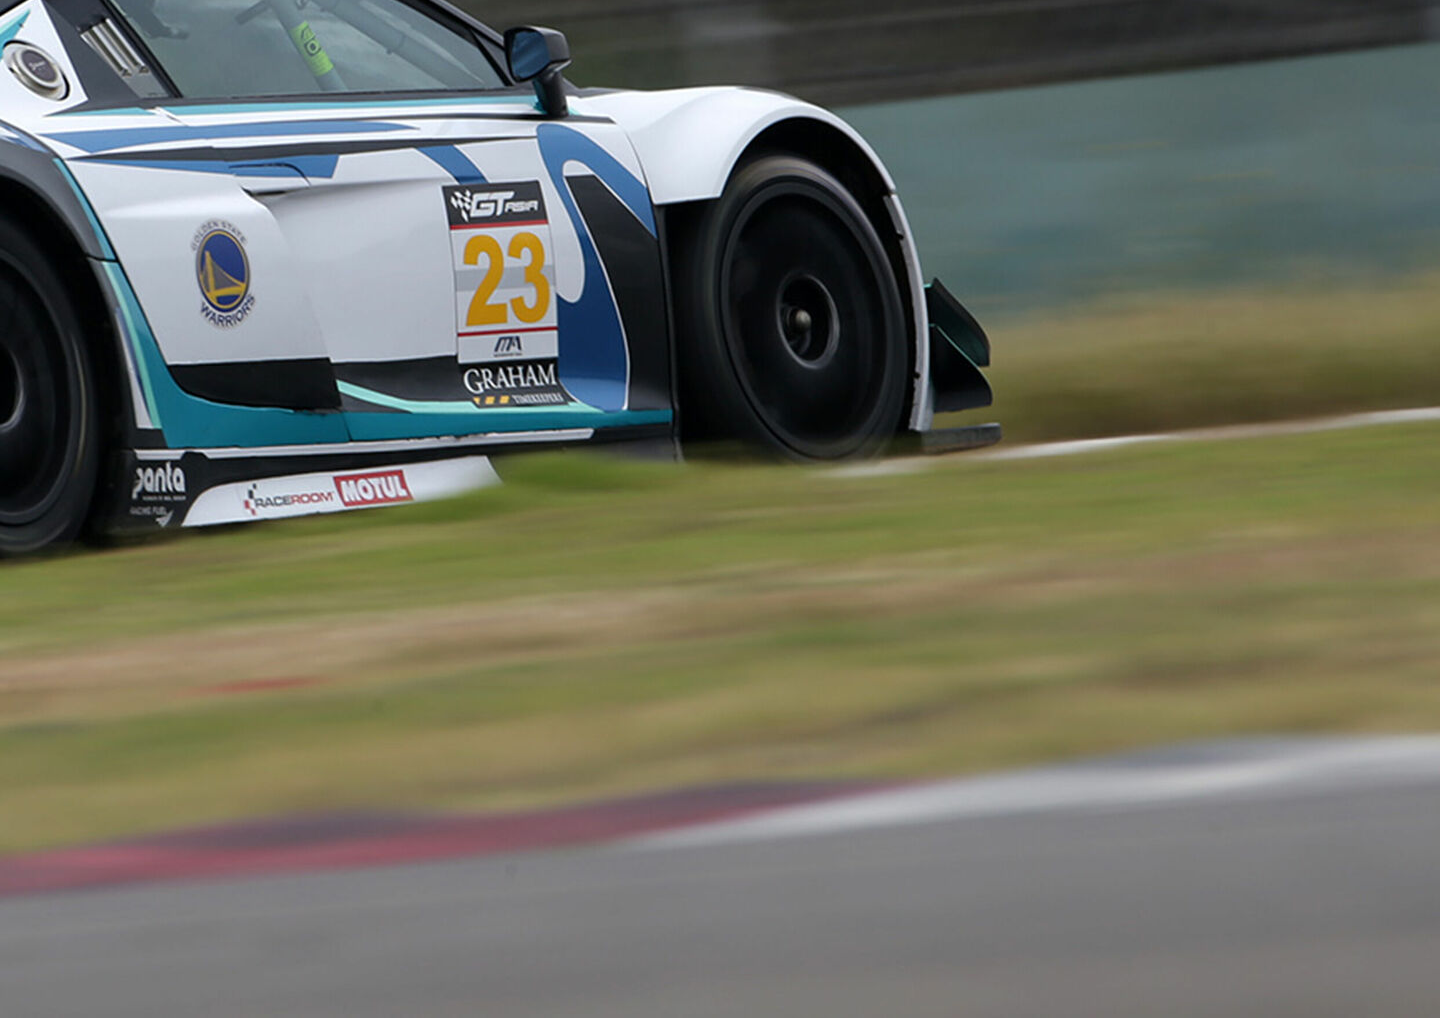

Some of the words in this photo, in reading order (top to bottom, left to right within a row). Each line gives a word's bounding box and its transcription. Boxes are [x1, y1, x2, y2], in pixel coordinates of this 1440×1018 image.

[470, 190, 515, 218] GT
[463, 231, 551, 327] 23
[201, 294, 256, 327] WARRIORS
[463, 363, 558, 395] GRAHAM
[255, 491, 334, 508] RACEROOM
[340, 475, 408, 504] MOTUL
